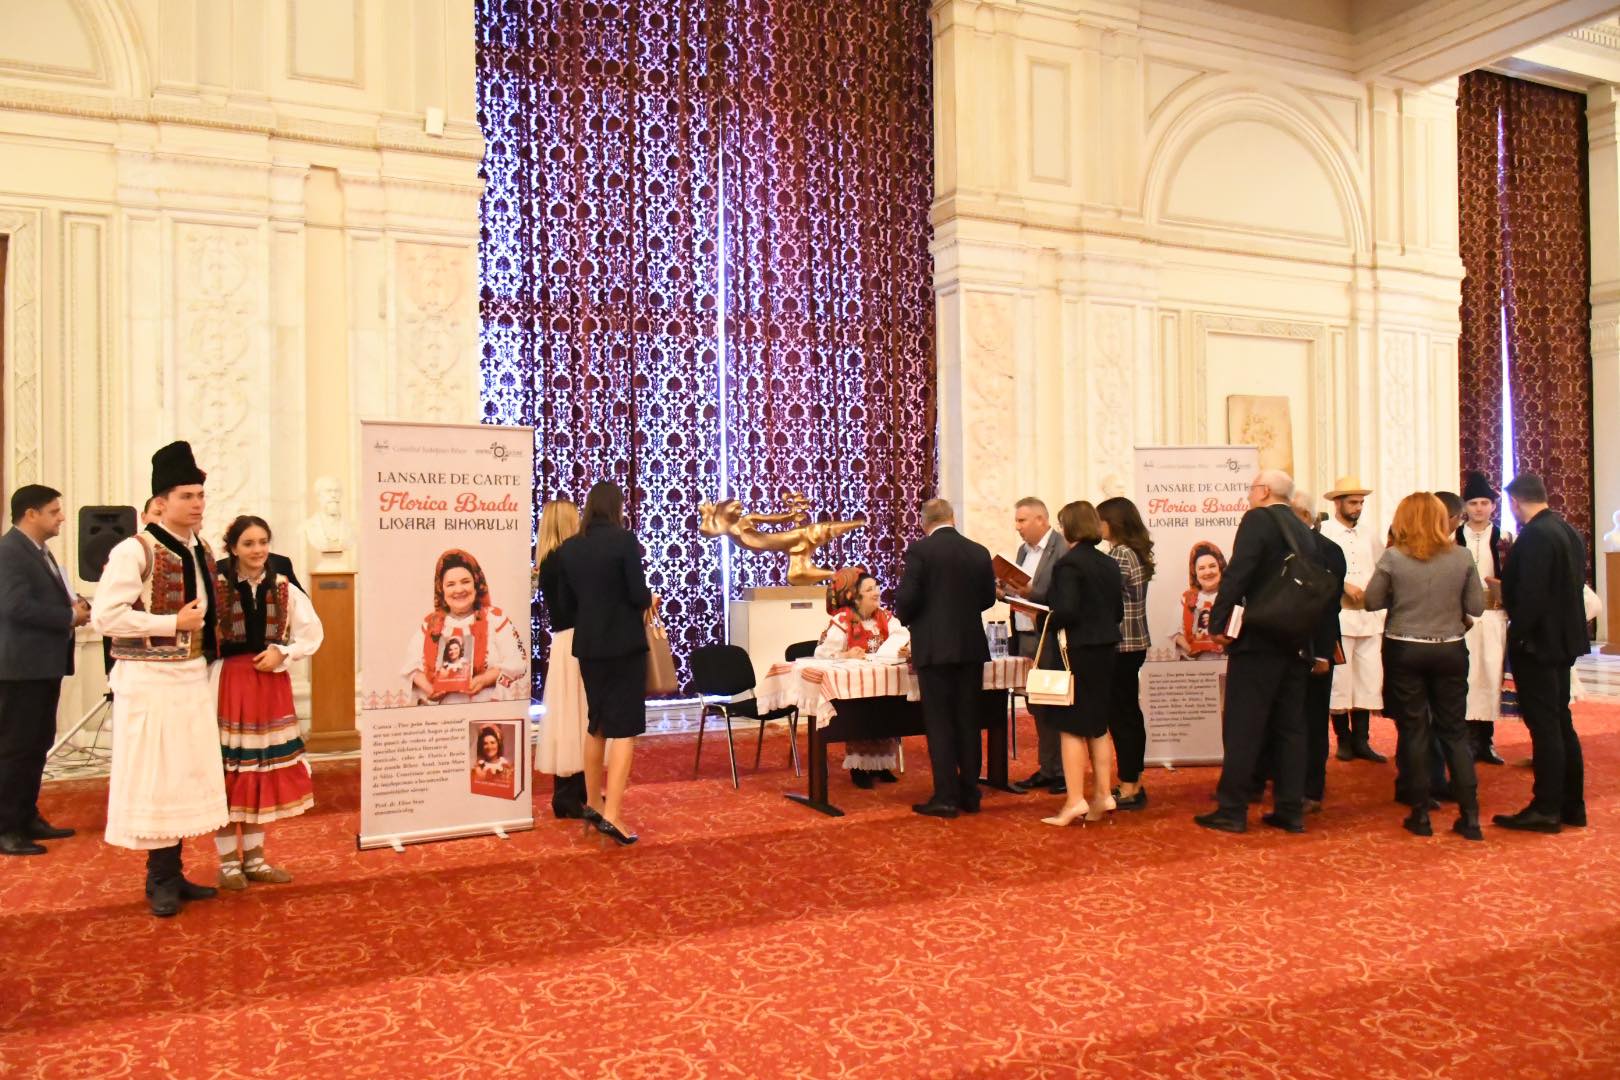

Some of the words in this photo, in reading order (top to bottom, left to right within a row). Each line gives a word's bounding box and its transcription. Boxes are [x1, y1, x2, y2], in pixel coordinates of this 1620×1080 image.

[378, 471, 447, 485] LANSARE
[450, 473, 470, 485] DE
[473, 474, 521, 486] CARTE
[1147, 484, 1195, 493] LANSARE
[1198, 483, 1213, 492] DE
[379, 491, 448, 512] Florica
[454, 492, 518, 513] Bradu
[1148, 498, 1197, 514] Florica
[1202, 497, 1249, 513] Bradu
[379, 517, 436, 530] LIOARA
[444, 517, 519, 531] BIHORULUI
